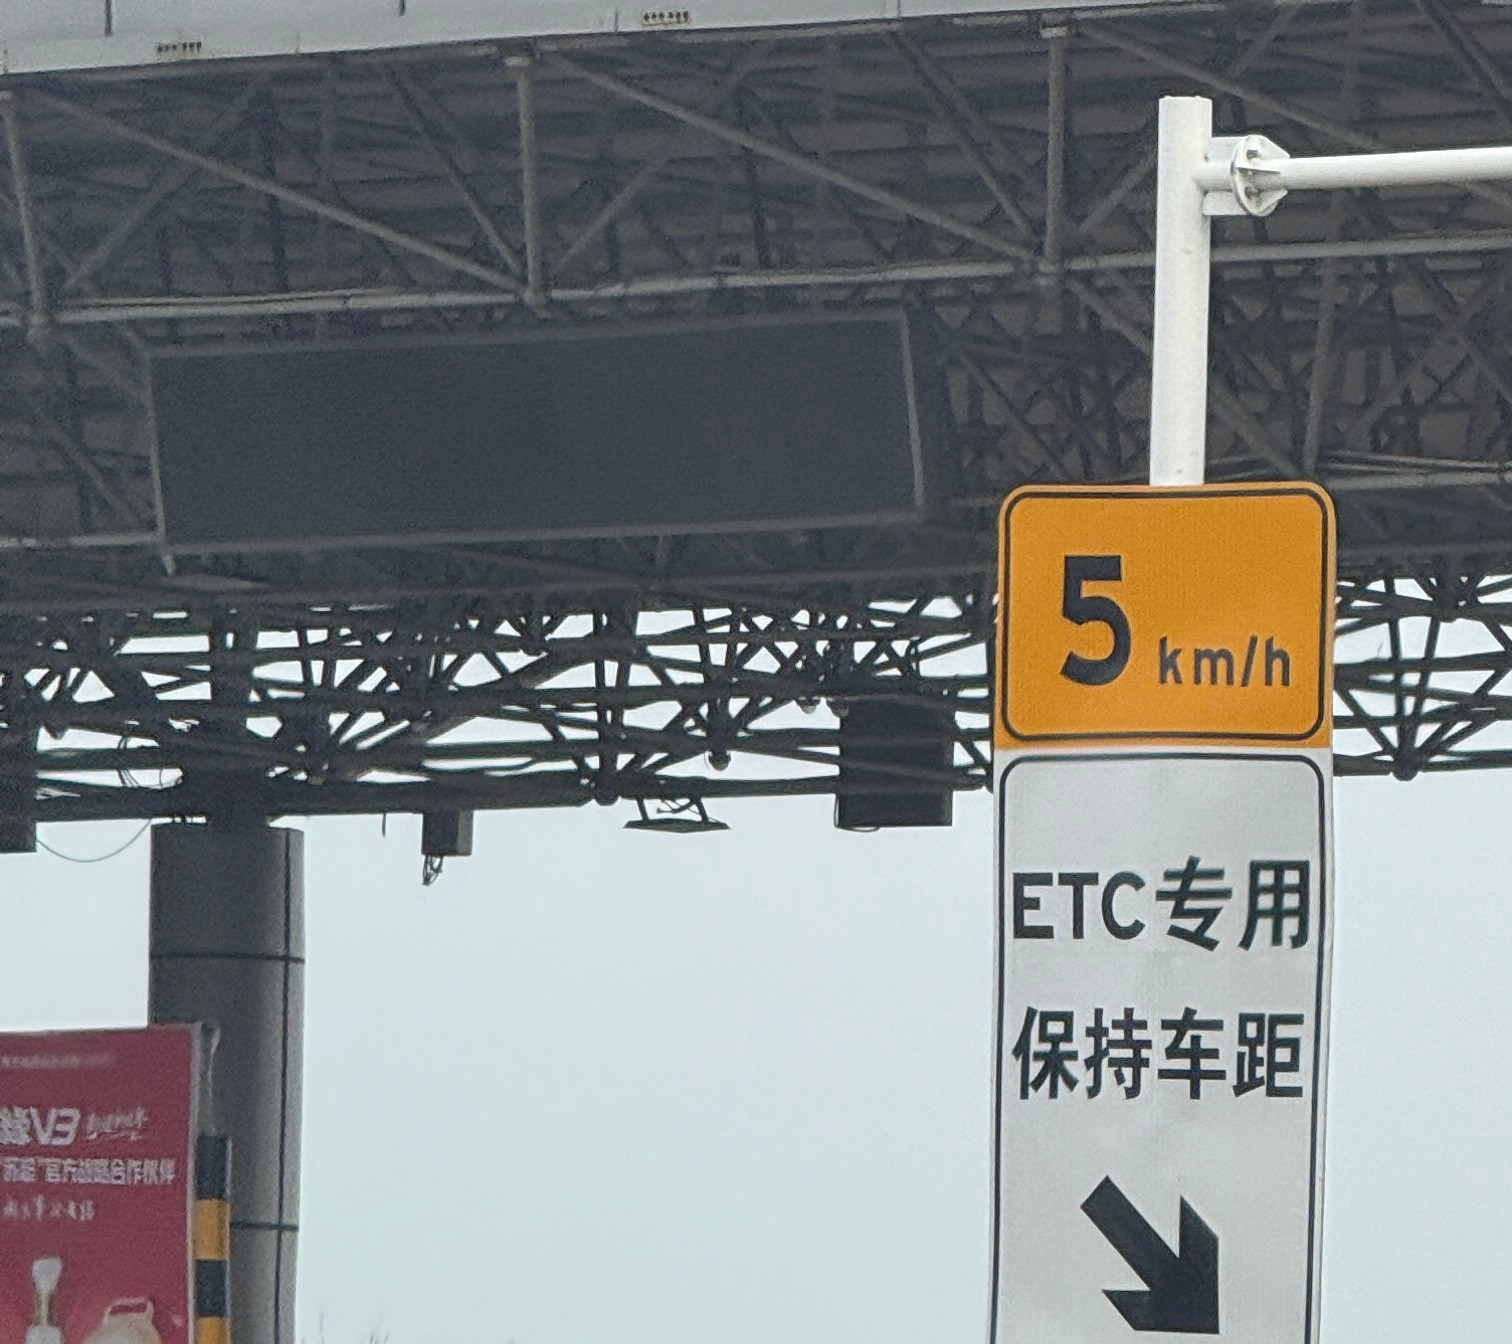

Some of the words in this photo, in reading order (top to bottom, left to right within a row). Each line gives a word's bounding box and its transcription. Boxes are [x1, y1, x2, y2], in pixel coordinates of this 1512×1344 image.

[1060, 554, 1133, 687] 5
[1158, 635, 1291, 688] km/h
[1012, 855, 1312, 951] ETC专用
[1011, 1005, 1305, 1100] 保持车距
